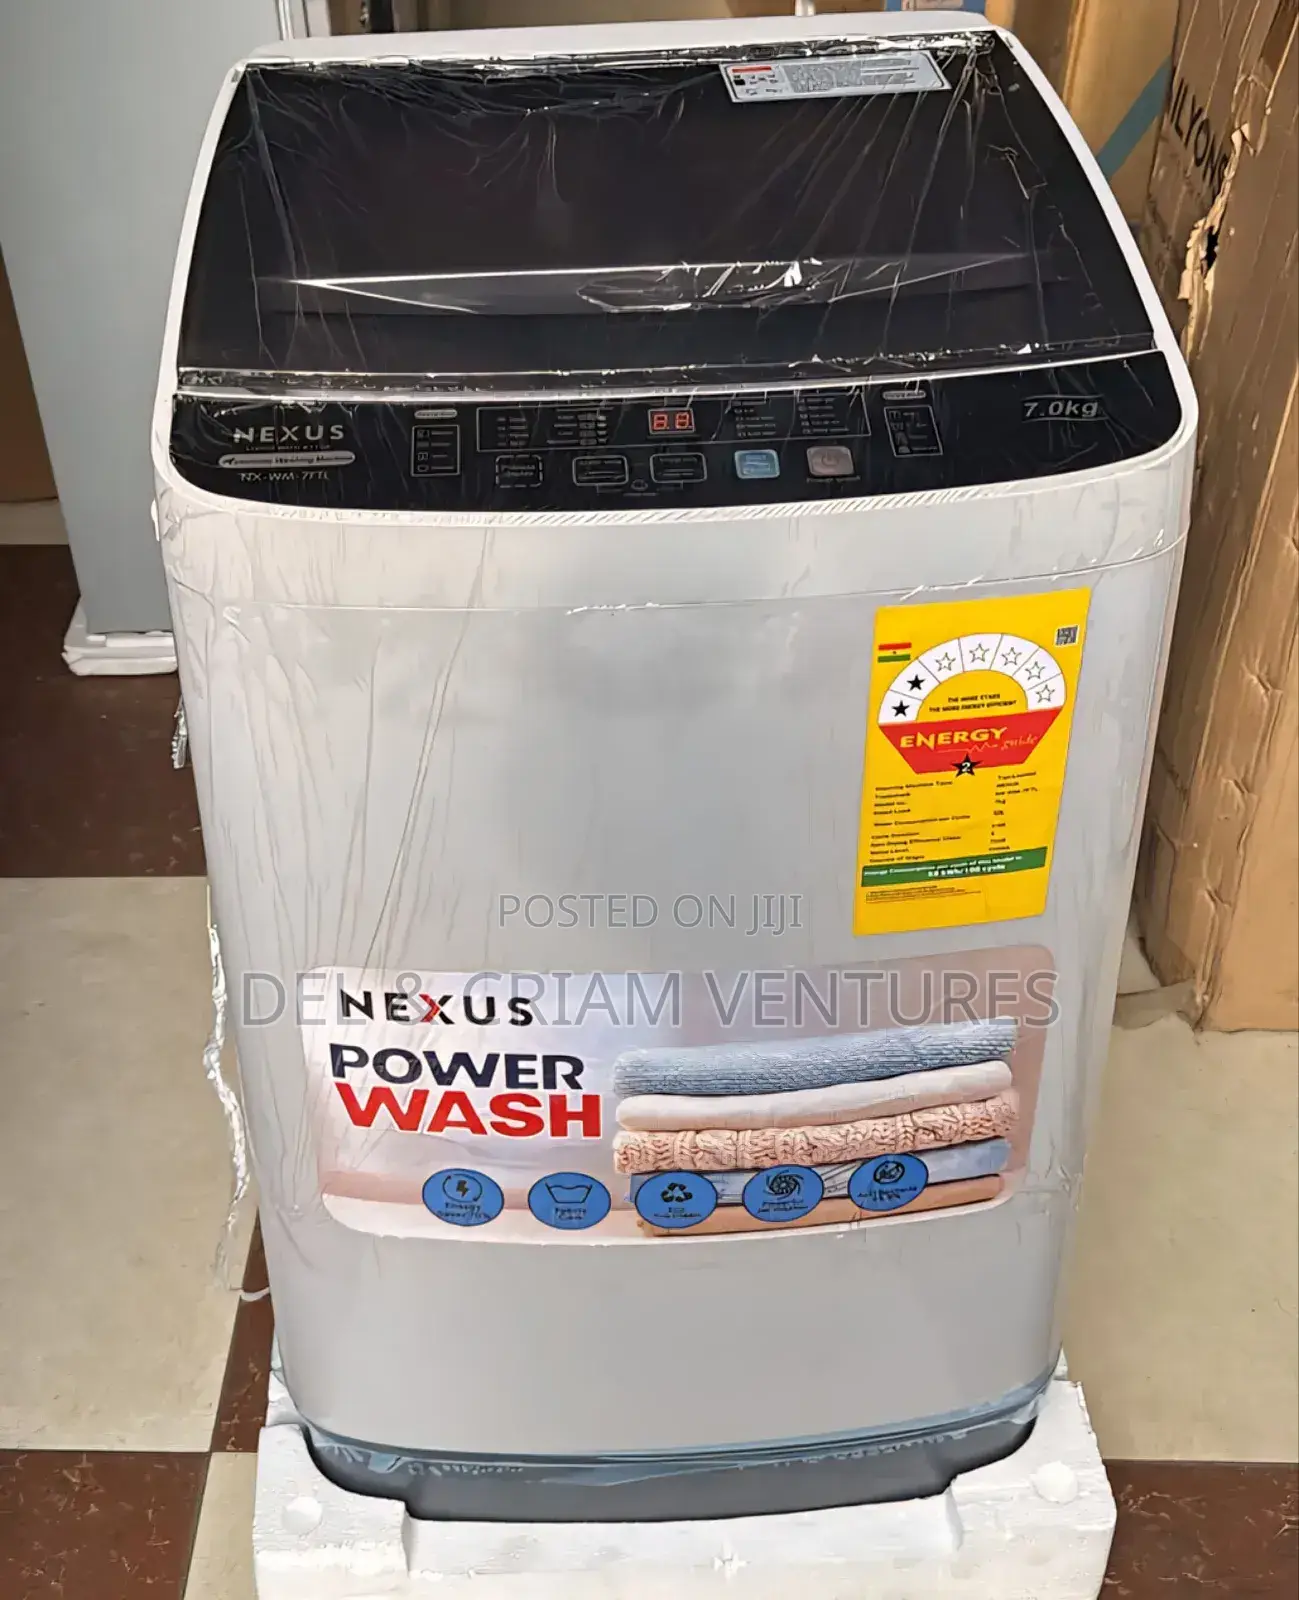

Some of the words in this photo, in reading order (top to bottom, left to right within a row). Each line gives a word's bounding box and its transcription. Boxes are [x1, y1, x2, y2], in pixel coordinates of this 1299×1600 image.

[1023, 399, 1099, 418] 7.0kg
[232, 423, 346, 445] NEXUS
[899, 727, 1008, 750] ENERGY
[961, 761, 971, 772] 2
[340, 987, 534, 1027] NEXUS
[329, 1043, 585, 1091] POWER
[334, 1082, 602, 1139] WASH
